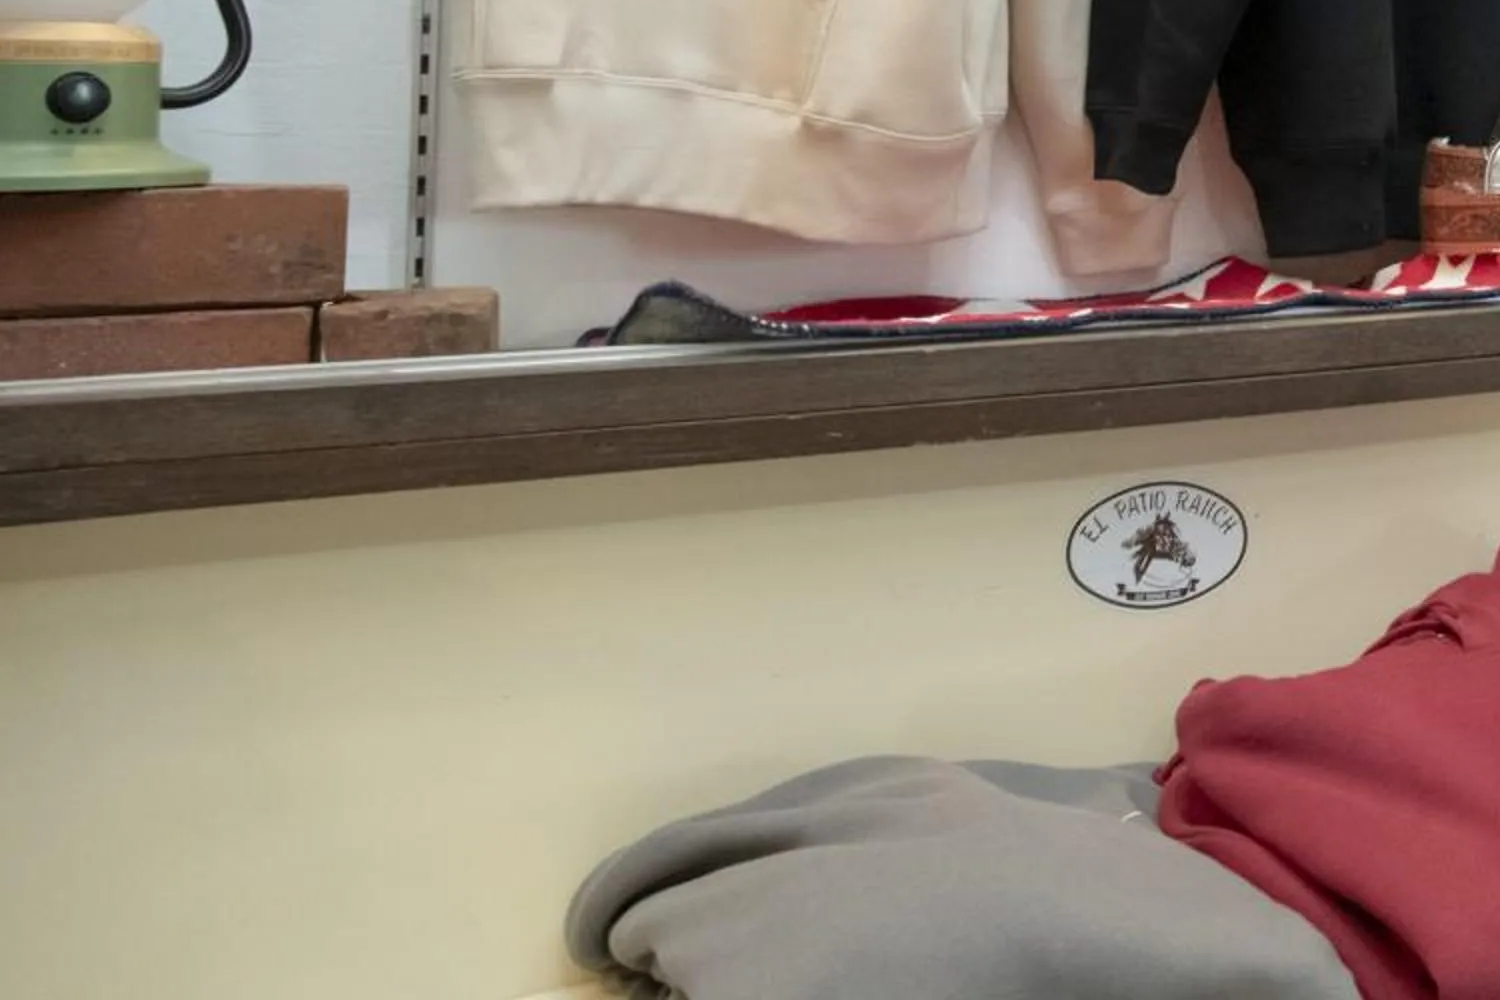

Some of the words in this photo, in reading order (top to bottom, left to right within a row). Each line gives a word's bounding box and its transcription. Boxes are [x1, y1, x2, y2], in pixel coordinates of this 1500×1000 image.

[1080, 515, 1110, 543] EL
[1113, 490, 1167, 521] PATIO
[1175, 490, 1238, 536] RANCH
